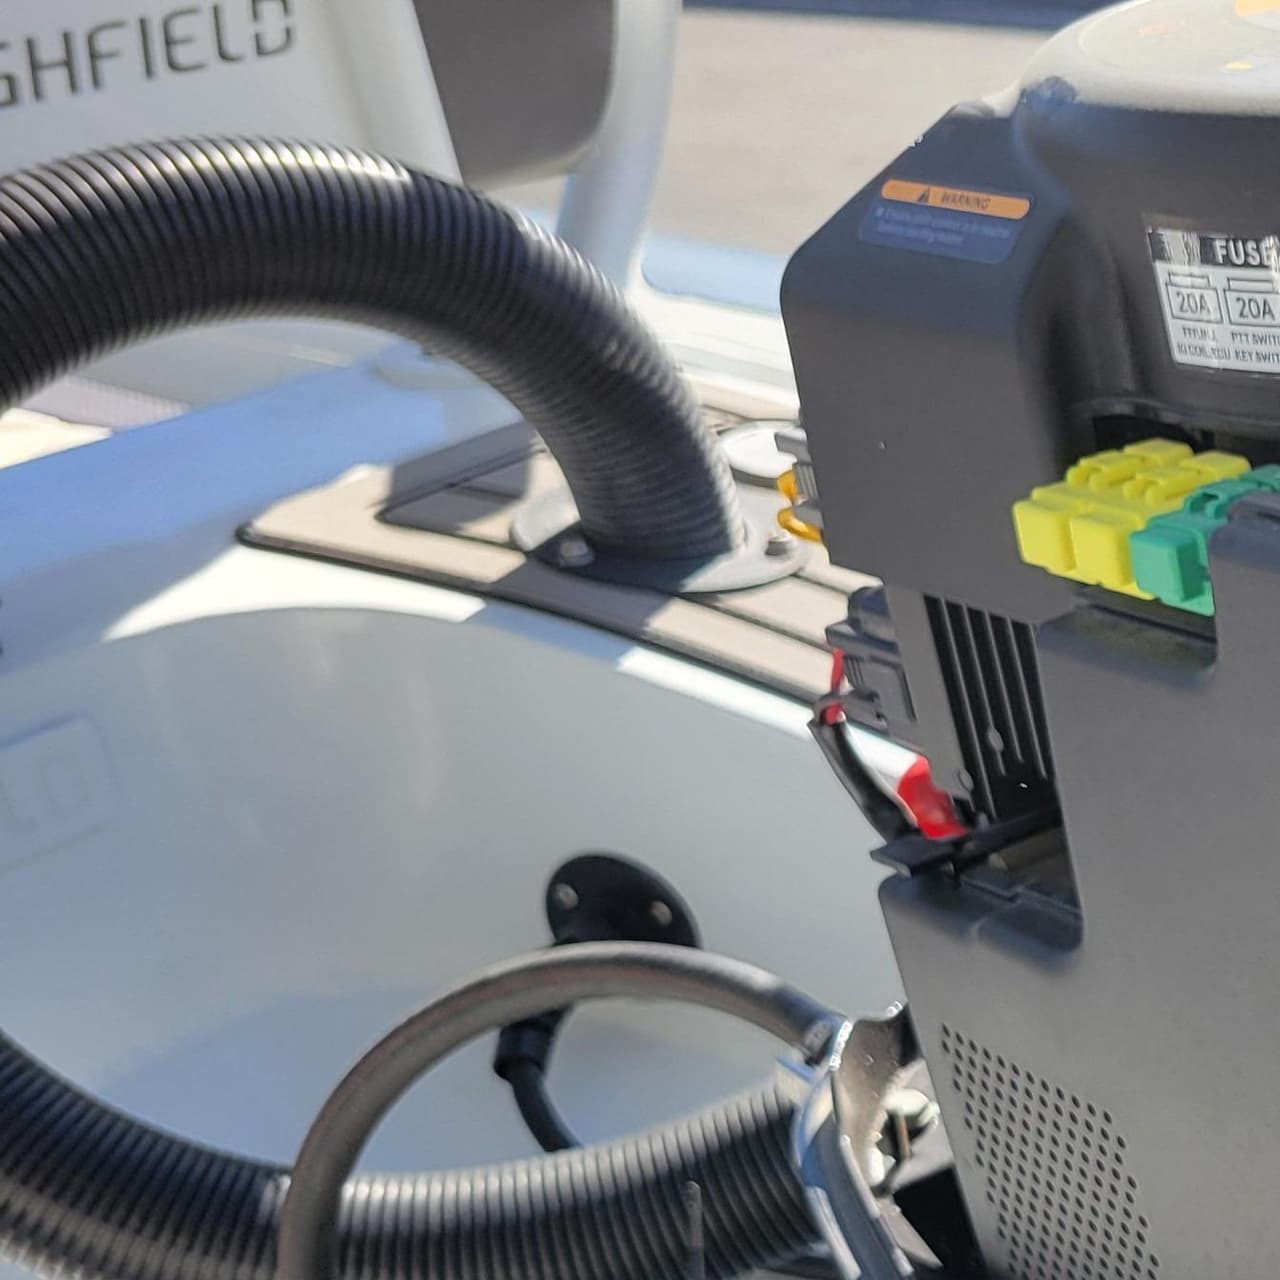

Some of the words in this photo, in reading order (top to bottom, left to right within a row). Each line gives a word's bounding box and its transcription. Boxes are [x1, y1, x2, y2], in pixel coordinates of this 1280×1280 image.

[1213, 237, 1277, 267] FUSE
[1176, 290, 1211, 315] 20A
[1236, 296, 1276, 321] 20A
